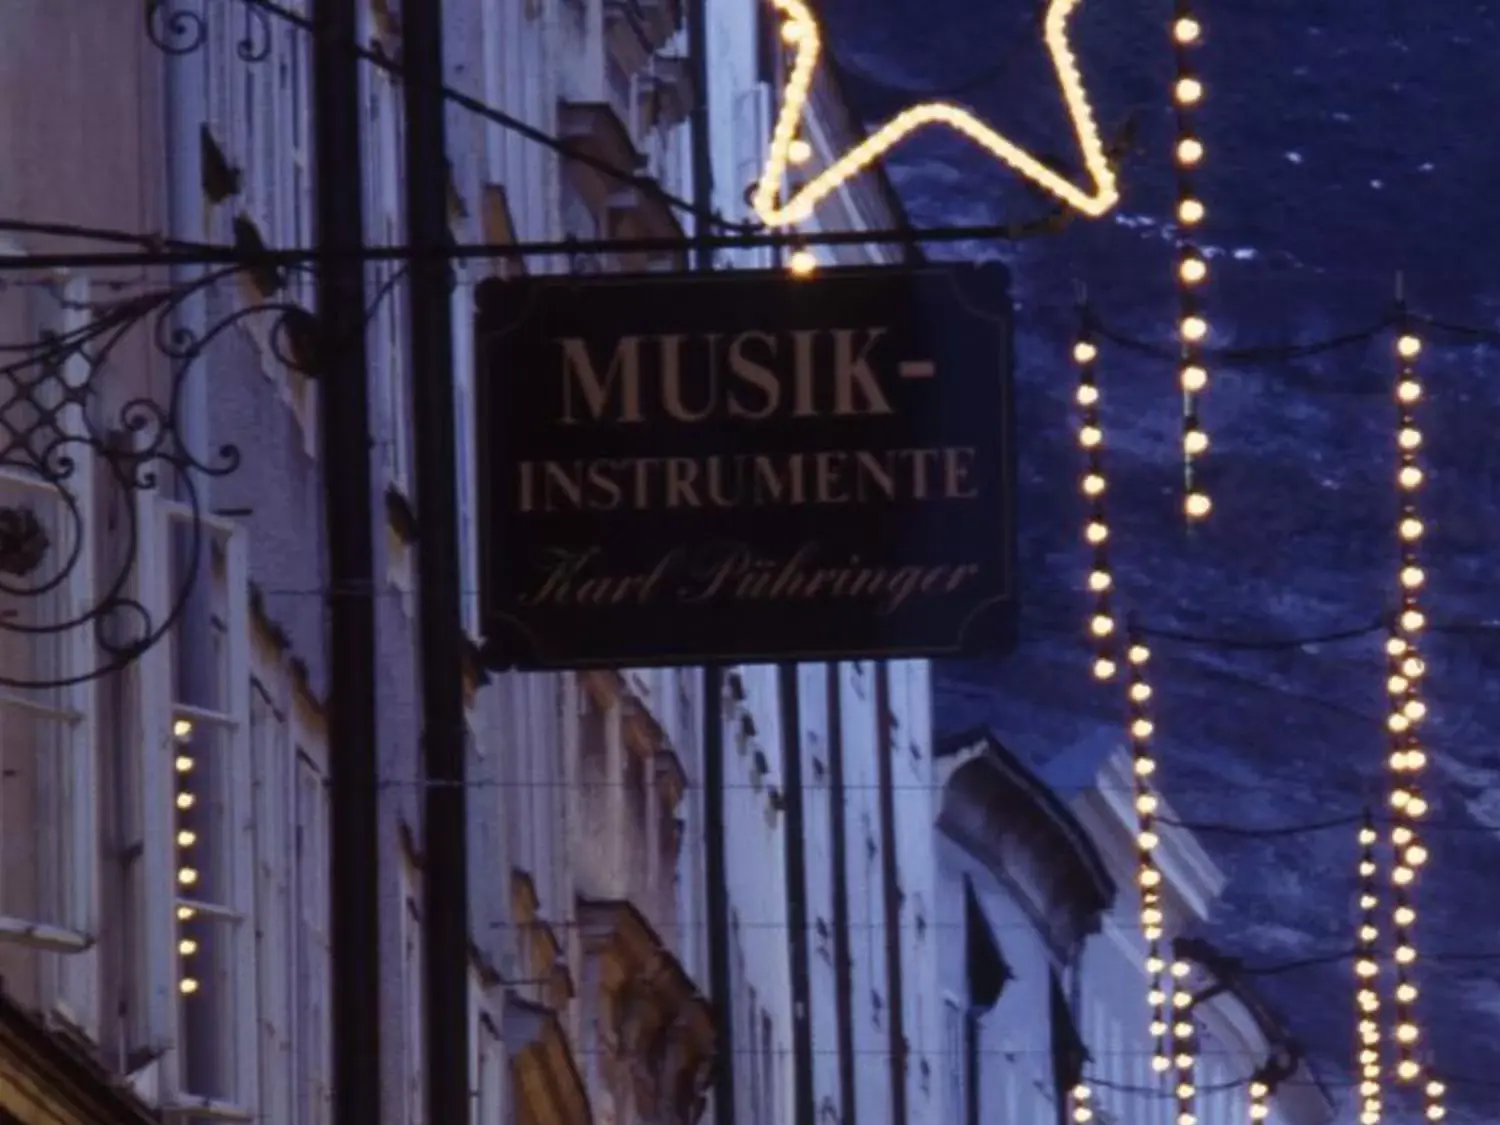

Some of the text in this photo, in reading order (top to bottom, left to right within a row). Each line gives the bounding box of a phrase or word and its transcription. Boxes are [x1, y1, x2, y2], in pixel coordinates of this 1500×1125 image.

[557, 328, 934, 424] MUSIK-
[518, 448, 979, 512] INSTRUMENTE
[517, 540, 979, 614] Karl Pühringer
